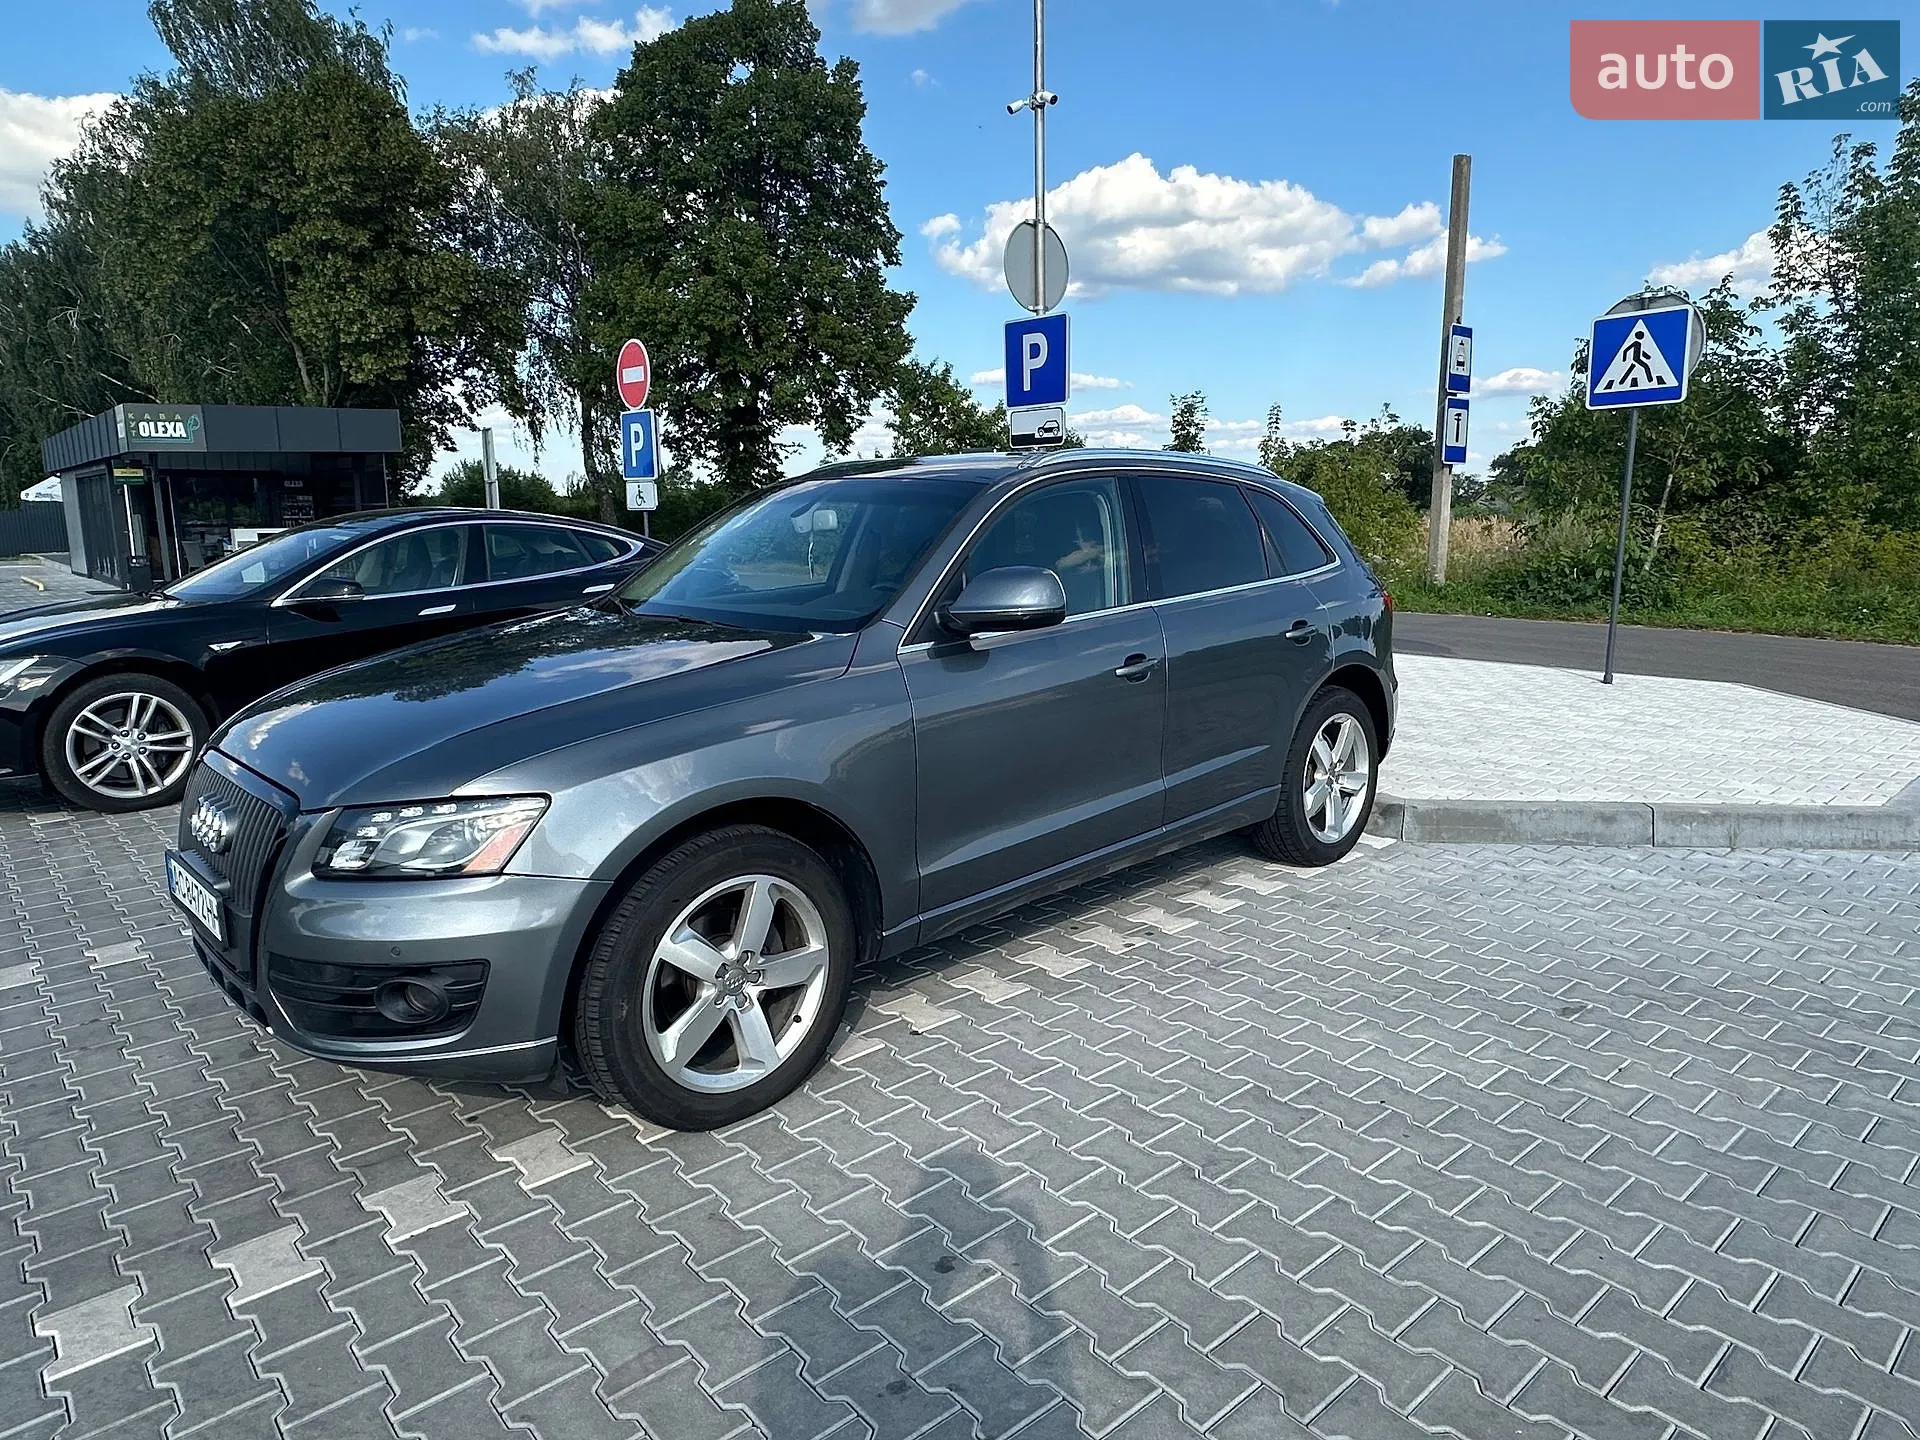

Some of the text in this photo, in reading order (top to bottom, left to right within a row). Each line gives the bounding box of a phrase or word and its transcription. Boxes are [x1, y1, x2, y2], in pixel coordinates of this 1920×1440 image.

[1022, 332, 1048, 392] P
[138, 421, 187, 438] OLEXA
[629, 422, 645, 468] P
